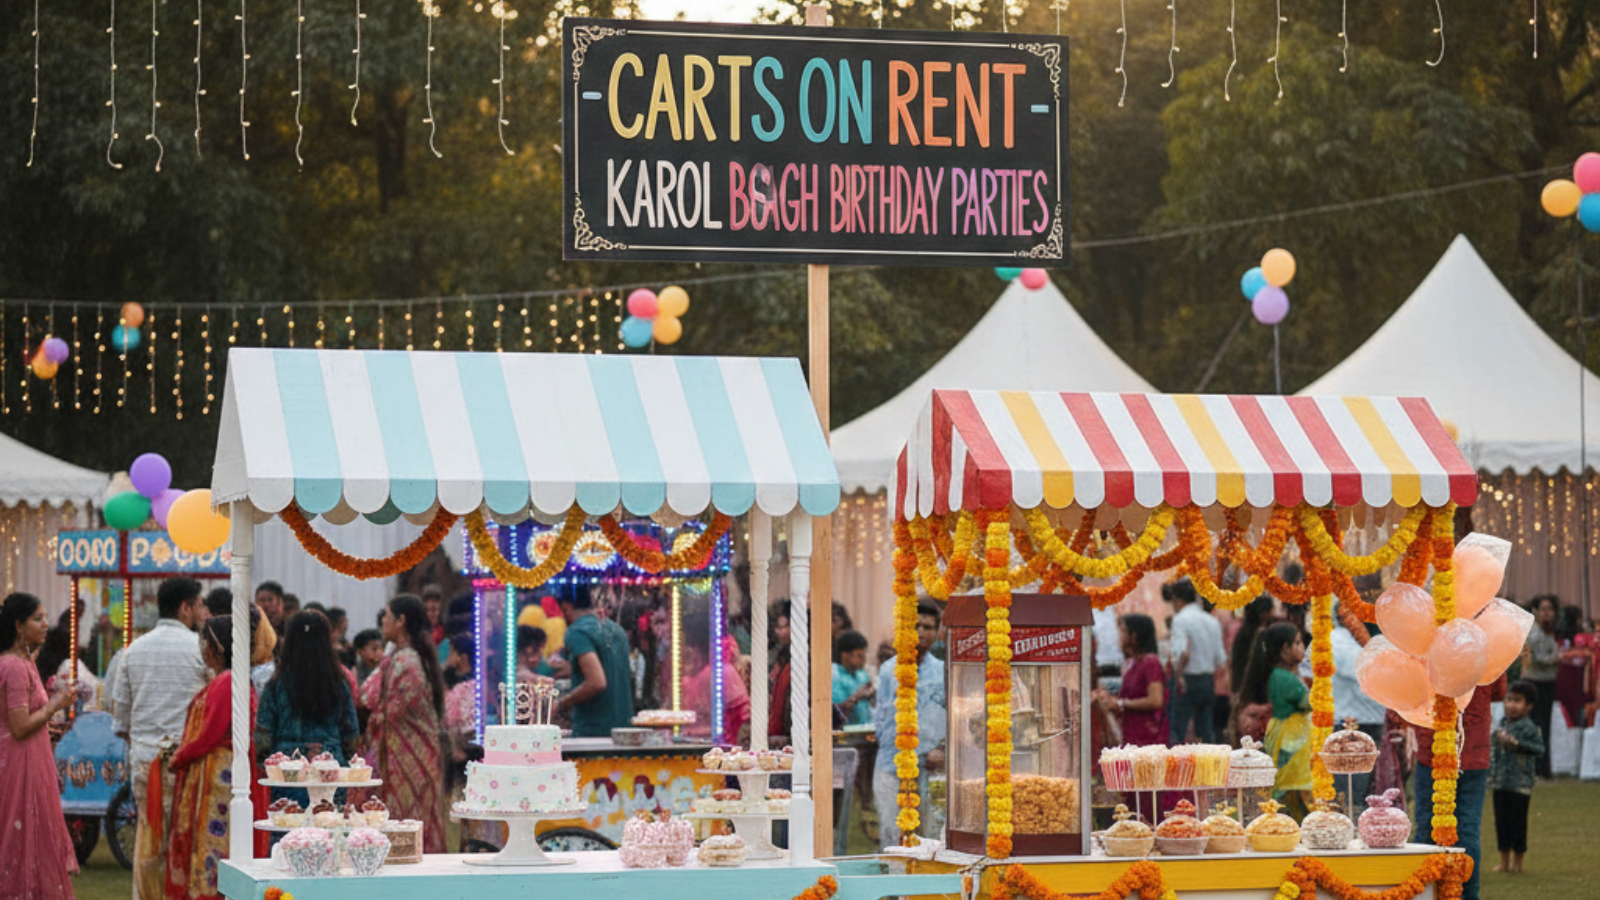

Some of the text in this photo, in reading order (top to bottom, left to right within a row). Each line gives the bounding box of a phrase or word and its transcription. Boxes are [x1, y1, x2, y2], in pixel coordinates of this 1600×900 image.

[800, 57, 872, 144] ON
[607, 159, 722, 230] KAROL
[830, 164, 945, 235] BIRTHDAY
[951, 167, 1050, 237] PARTIES
